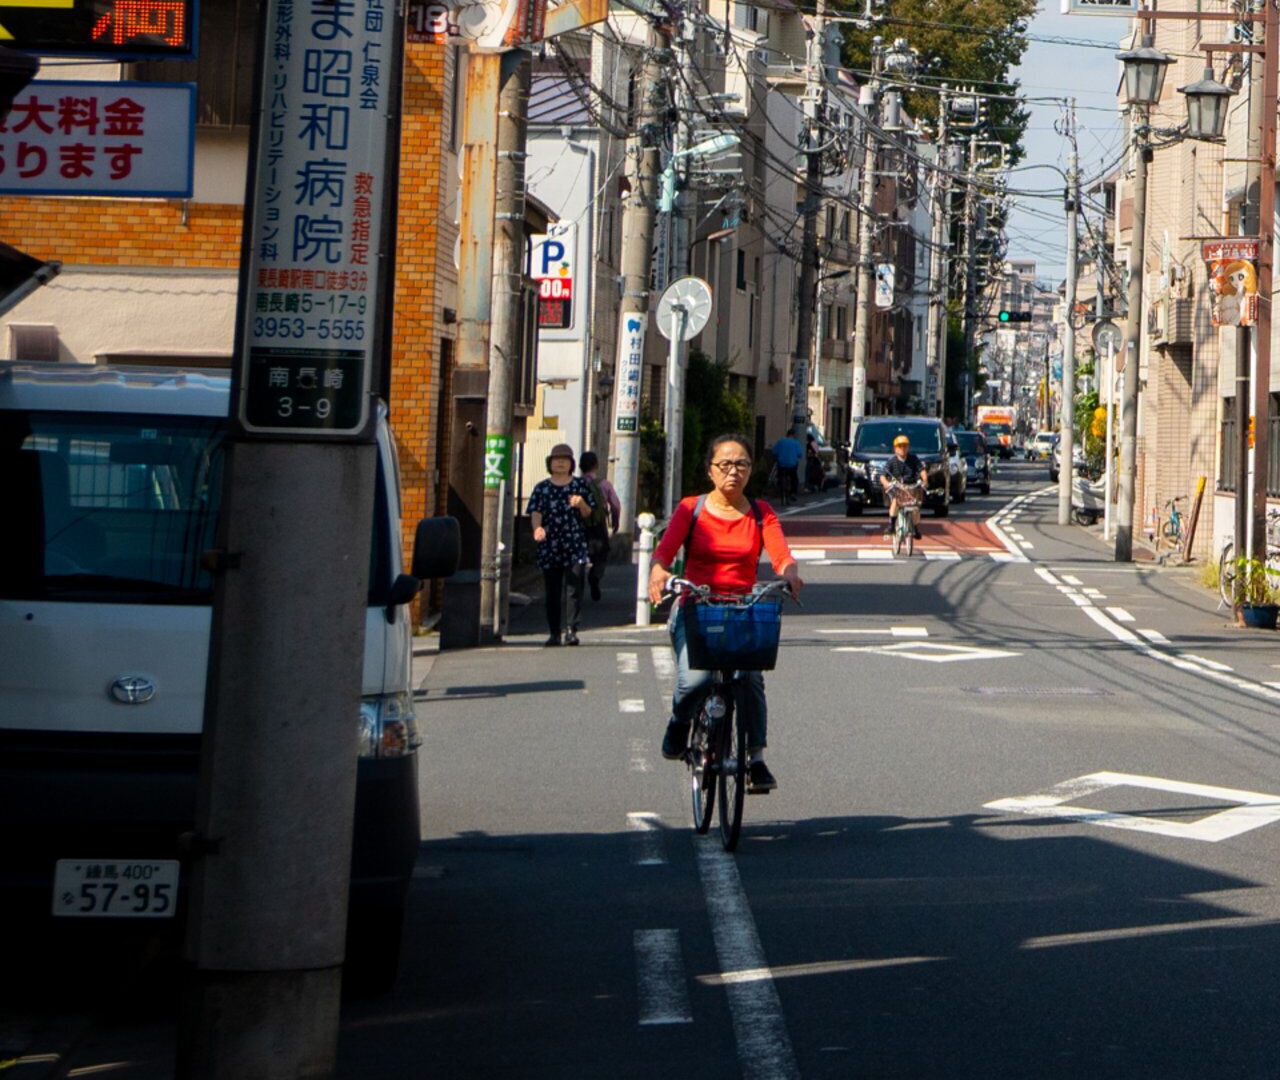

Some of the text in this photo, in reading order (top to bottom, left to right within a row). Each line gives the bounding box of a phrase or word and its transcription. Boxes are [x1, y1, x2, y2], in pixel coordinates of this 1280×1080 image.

[360, 40, 382, 111] 仁泉会
[0, 95, 146, 136] 大料金
[350, 171, 375, 265] 救急指定
[541, 240, 565, 275] P
[257, 267, 369, 291] 東長崎駅南口徒歩3分
[254, 292, 368, 316] 南長崎5-17-9
[253, 316, 366, 341] 3953-5555
[277, 396, 331, 419] 3-9
[122, 864, 153, 880] 400
[79, 883, 171, 913] 57-95
